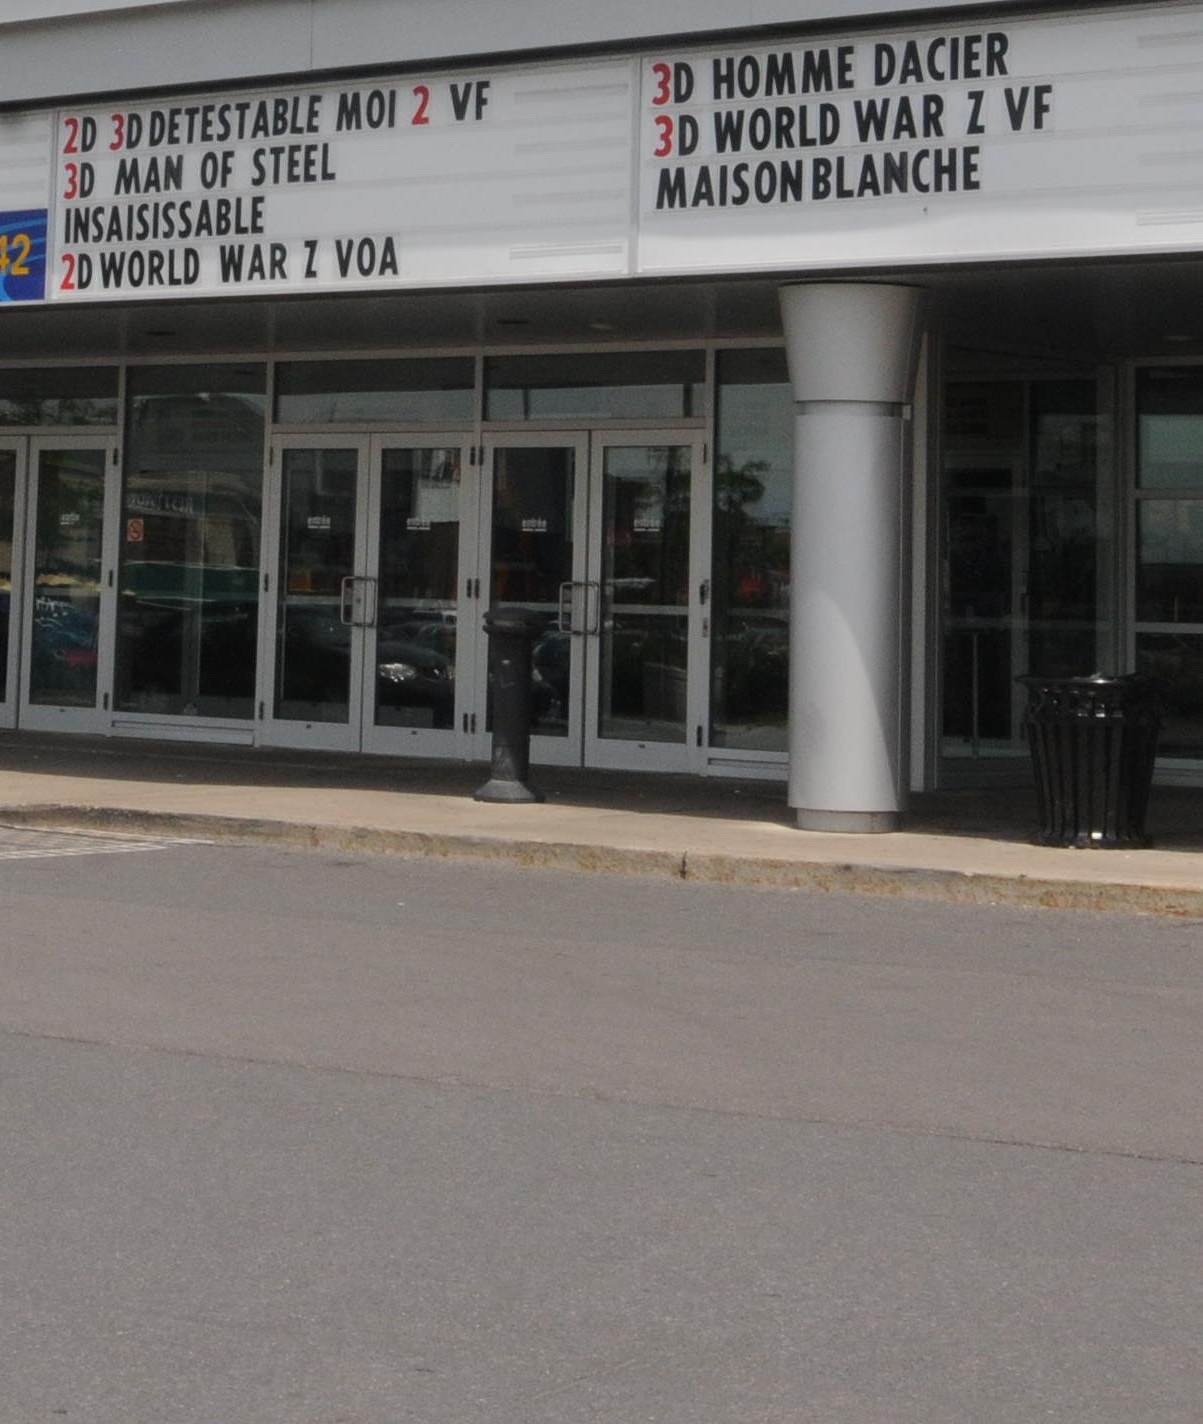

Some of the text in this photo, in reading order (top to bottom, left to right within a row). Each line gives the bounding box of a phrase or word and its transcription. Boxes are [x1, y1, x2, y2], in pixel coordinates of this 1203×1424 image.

[652, 32, 1008, 105] 3D HOMME DACIER
[62, 81, 491, 154] 2D 3D DETESTABLE MOI 2 VF
[654, 84, 1052, 158] 3D WORLD WAR Z VF
[63, 142, 336, 200] 3D MAN OF STEEL
[656, 145, 981, 210] MAISON BLANCHE
[64, 196, 265, 244] INSAISISSABLE
[60, 236, 398, 290] 2D WORLD WAR Z VOA
